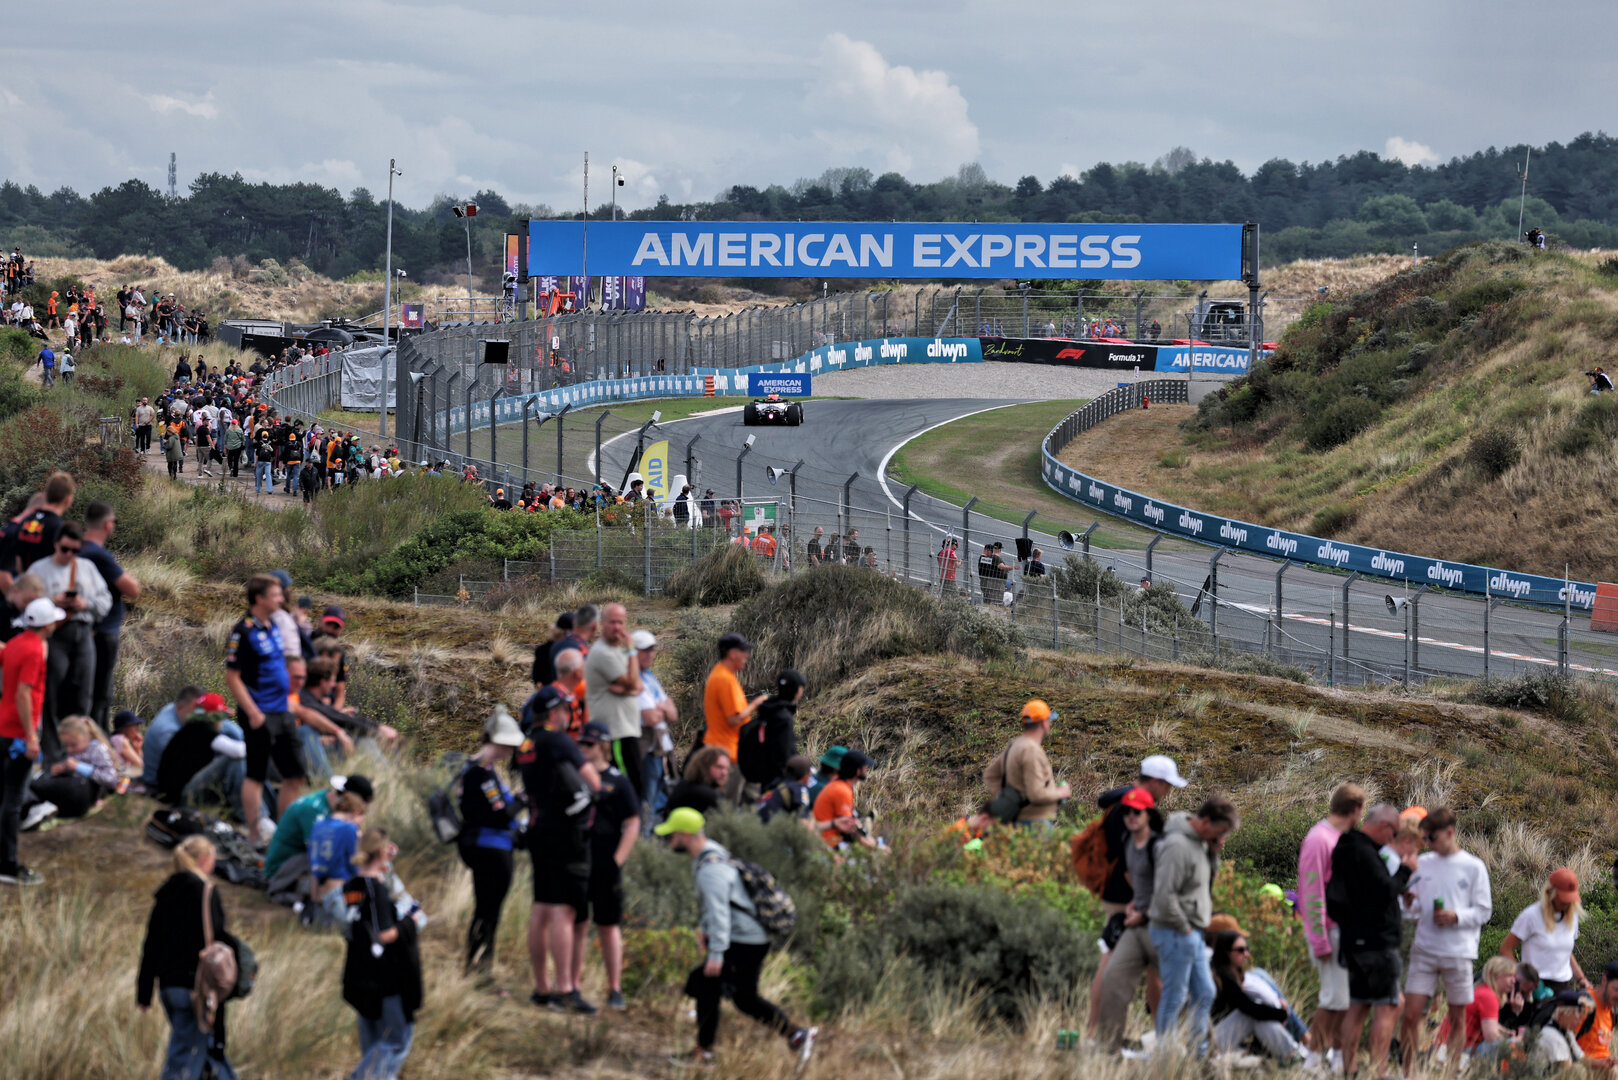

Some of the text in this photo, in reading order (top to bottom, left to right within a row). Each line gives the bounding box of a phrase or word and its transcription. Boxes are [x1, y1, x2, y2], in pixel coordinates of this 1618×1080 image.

[631, 232, 1142, 269] AMERICAN EXPRESS
[880, 338, 908, 363] allwyn
[926, 338, 968, 363] allwyn
[1108, 353, 1136, 362] Formula
[1171, 352, 1249, 369] AMERICAN
[757, 379, 802, 387] AMERICAN
[763, 386, 803, 394] EXPRESS
[648, 458, 664, 488] AID
[1143, 500, 1165, 525] allwyn
[1178, 510, 1204, 536] allwyn
[1219, 521, 1248, 546] allwyn
[1266, 531, 1298, 557] allwyn
[1317, 541, 1350, 567] allwyn
[1371, 551, 1405, 577] allwyn
[1427, 561, 1464, 588] allwyn
[1490, 572, 1531, 598] allwyn
